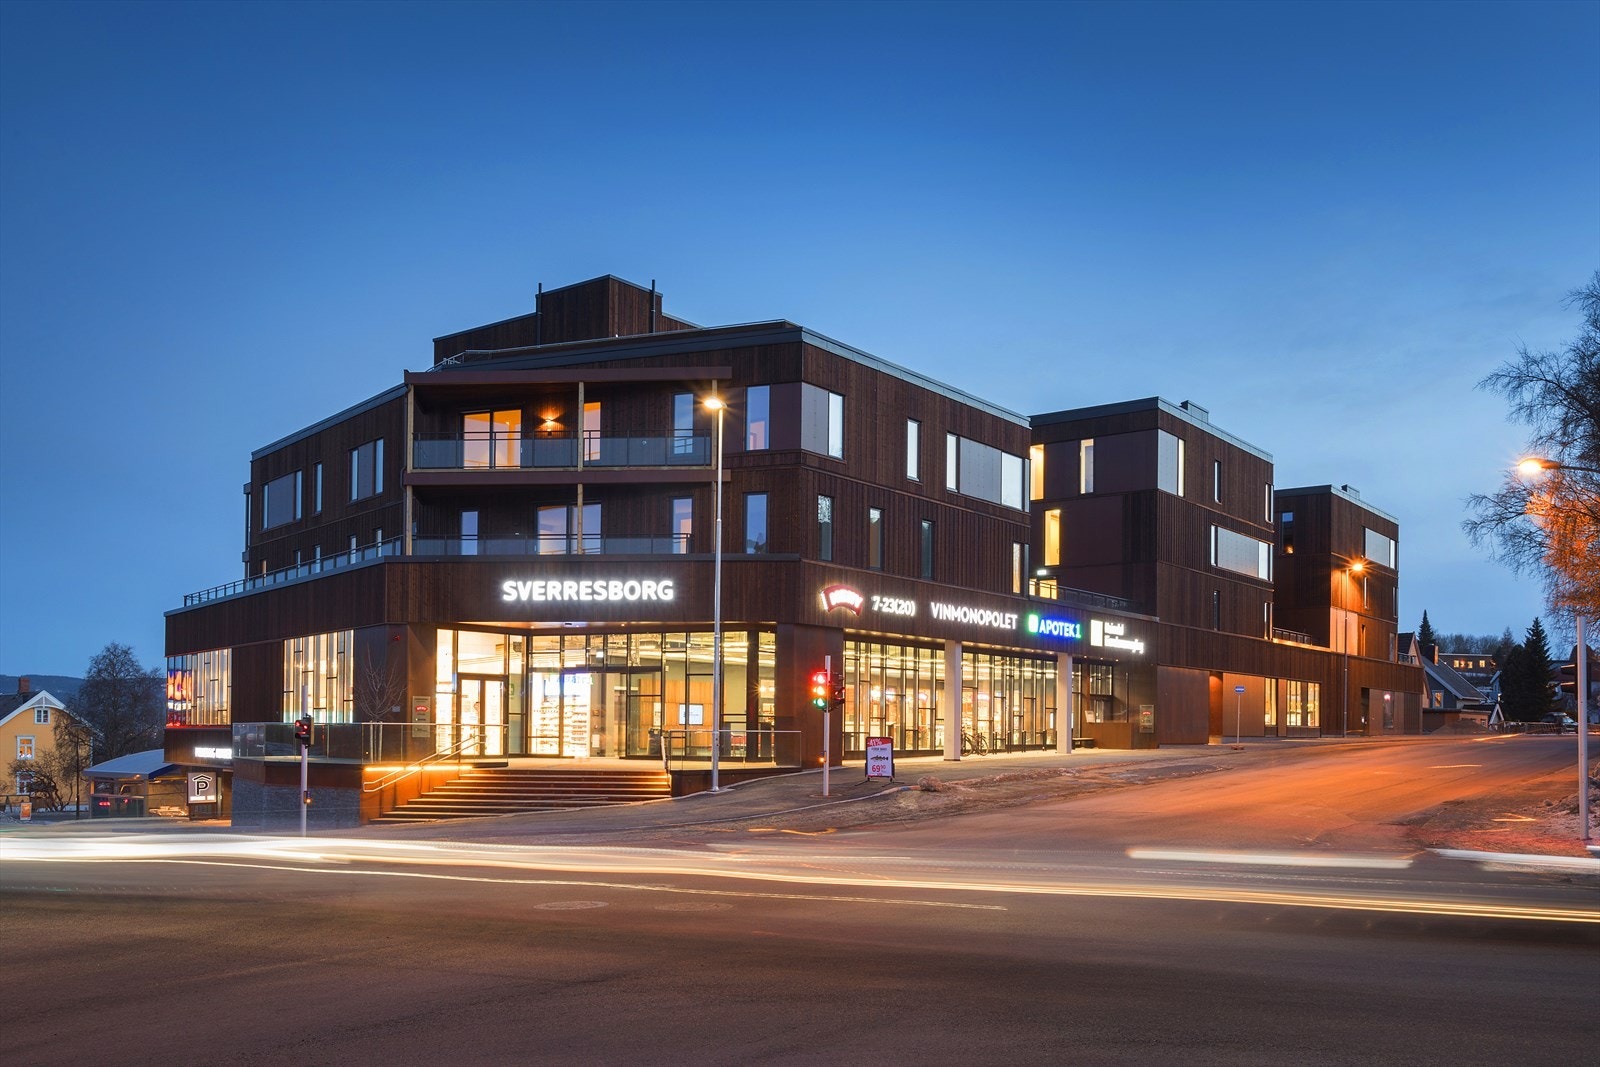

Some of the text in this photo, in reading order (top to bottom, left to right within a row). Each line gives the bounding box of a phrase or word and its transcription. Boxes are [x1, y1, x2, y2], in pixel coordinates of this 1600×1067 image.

[502, 580, 674, 601] SVERRESBORG
[871, 596, 915, 616] 7-23(20)
[931, 602, 1018, 630] VINMONOPOLET
